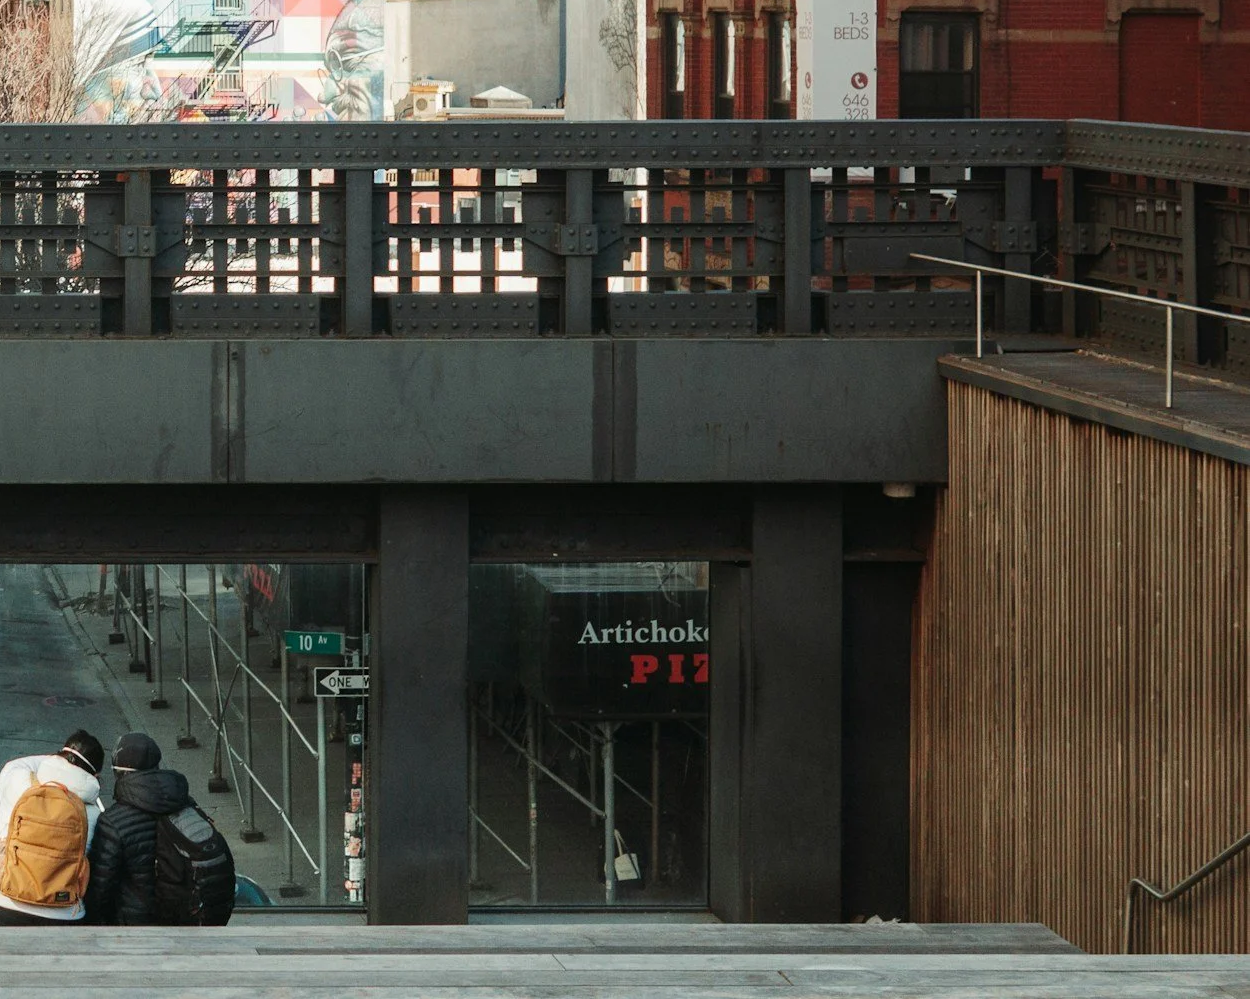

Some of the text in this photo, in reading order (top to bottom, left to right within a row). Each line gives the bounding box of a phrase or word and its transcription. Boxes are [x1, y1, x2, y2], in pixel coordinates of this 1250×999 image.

[849, 12, 869, 25] 1-3
[834, 26, 869, 40] BEDS
[842, 94, 869, 107] 646
[844, 108, 869, 120] 328
[299, 634, 328, 651] 10 Av
[328, 676, 352, 688] ONE
